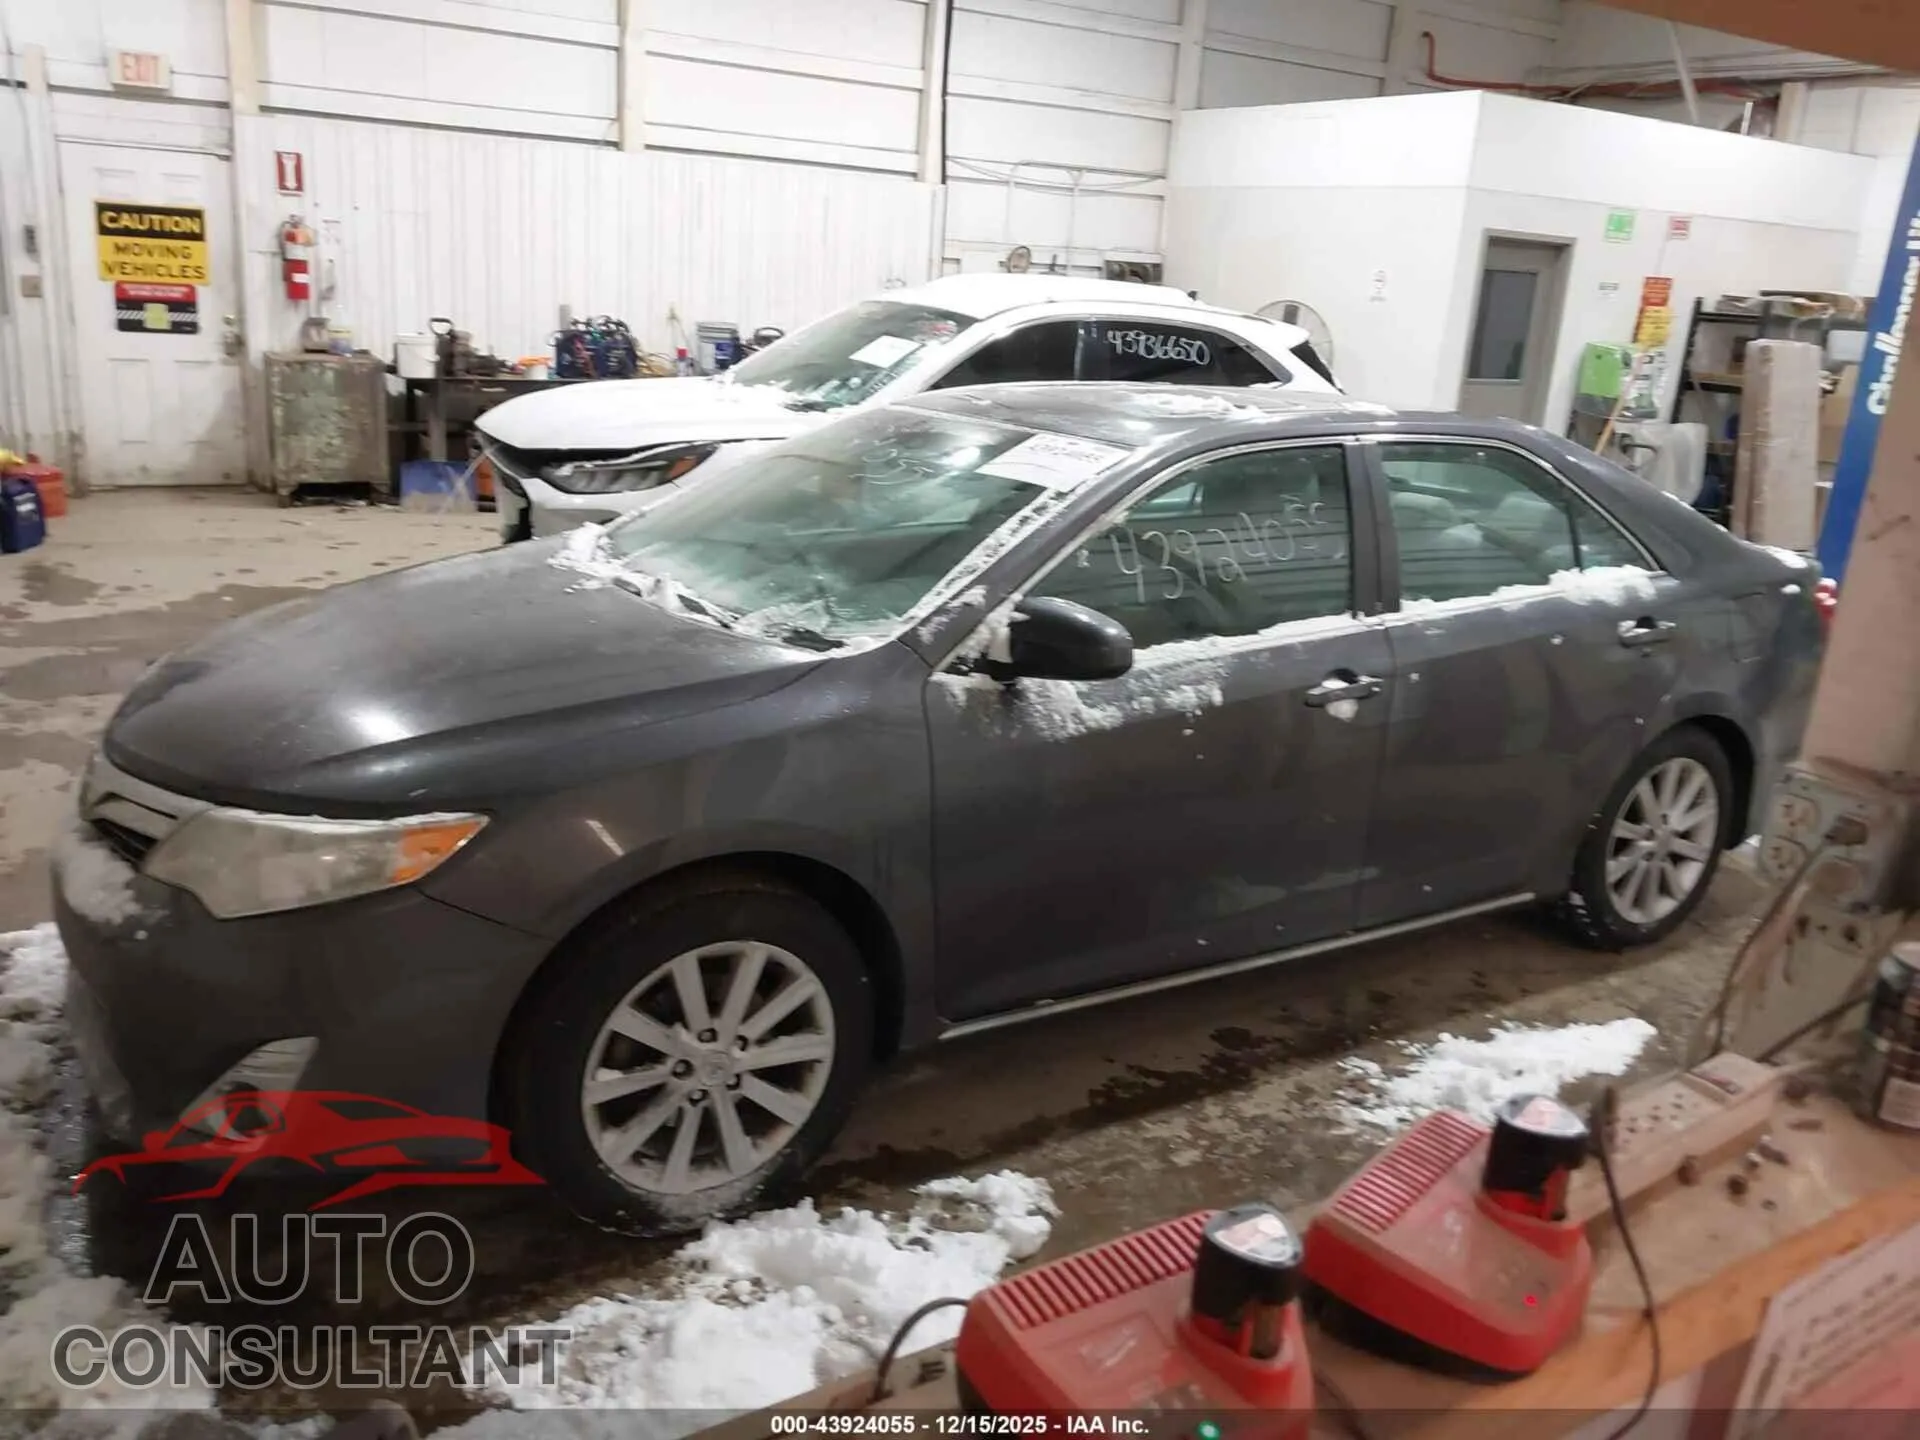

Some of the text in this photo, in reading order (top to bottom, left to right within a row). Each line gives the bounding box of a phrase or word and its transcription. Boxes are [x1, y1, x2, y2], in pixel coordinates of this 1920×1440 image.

[101, 211, 201, 234] CAUTION
[113, 243, 192, 259] MOVING
[102, 260, 206, 279] VEHICLES
